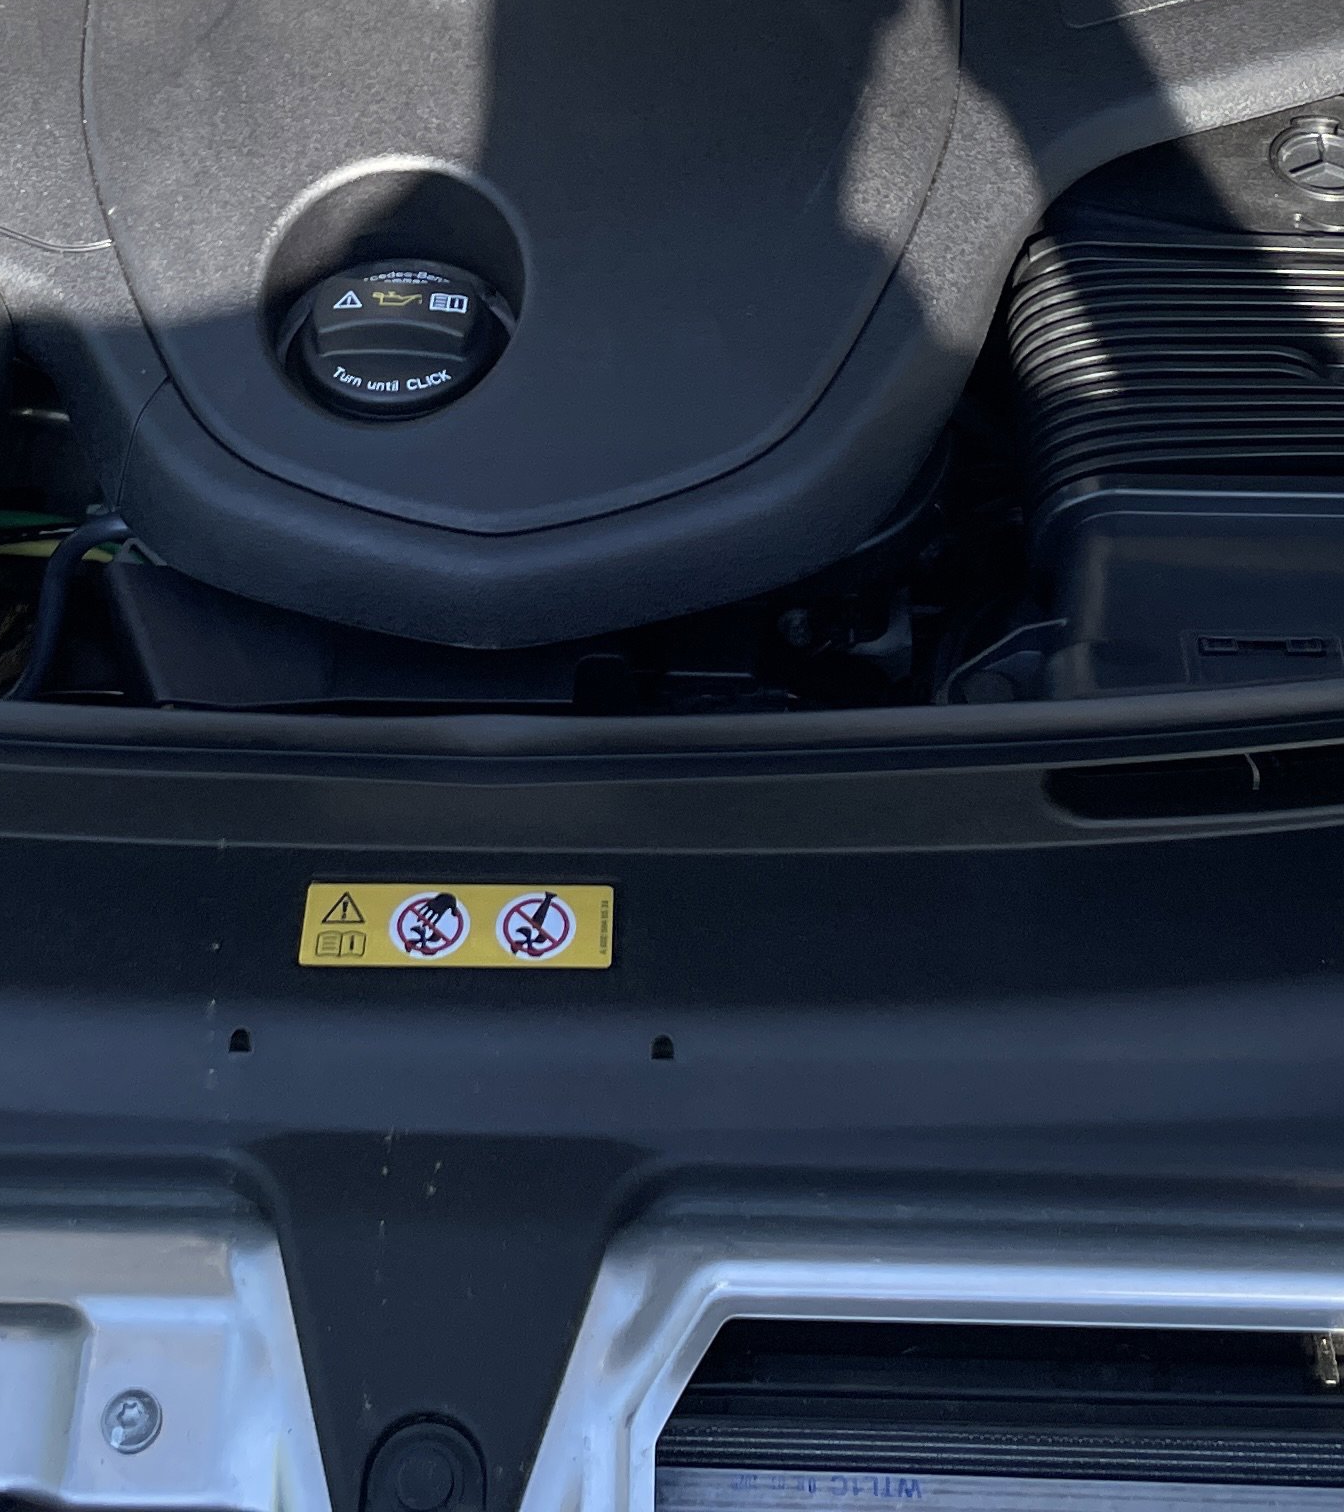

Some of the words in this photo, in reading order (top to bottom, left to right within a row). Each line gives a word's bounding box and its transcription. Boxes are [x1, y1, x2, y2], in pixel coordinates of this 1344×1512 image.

[333, 366, 361, 388] Turn
[367, 380, 399, 392] until
[406, 369, 452, 391] CLICK
